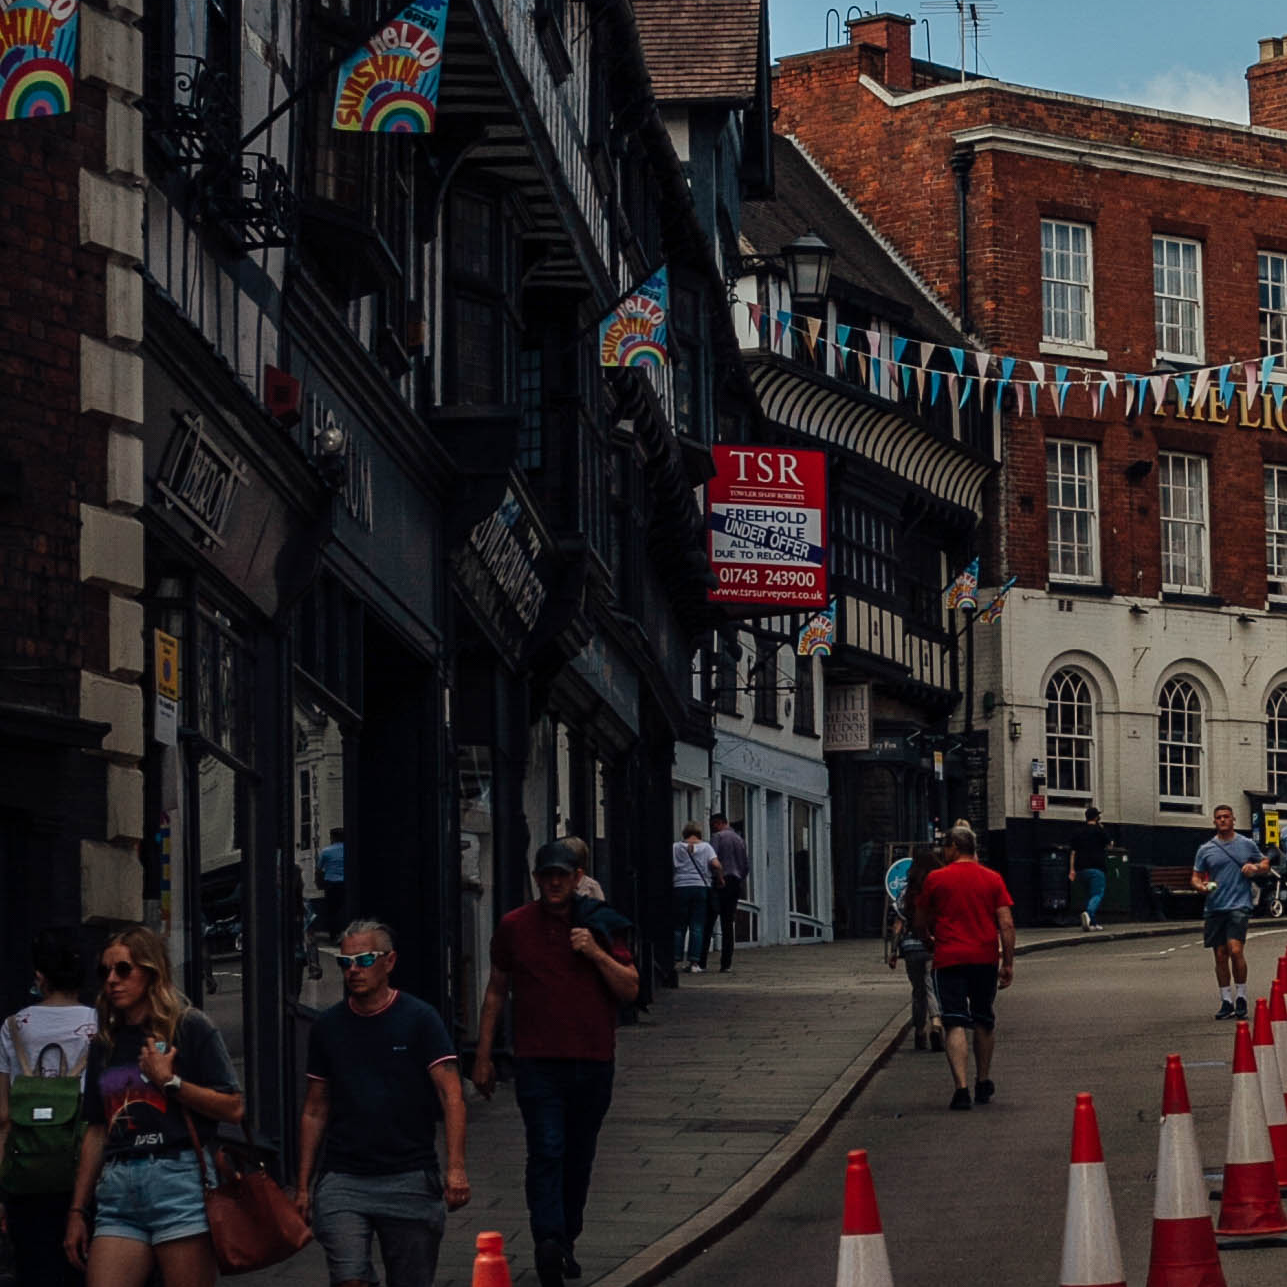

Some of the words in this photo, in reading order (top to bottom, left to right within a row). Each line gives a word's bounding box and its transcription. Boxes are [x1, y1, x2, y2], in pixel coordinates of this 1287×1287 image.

[404, 10, 439, 32] OPEN
[1153, 385, 1230, 425] HE
[729, 450, 804, 486] TSR
[729, 490, 757, 498] TOWLER
[758, 491, 776, 499] SHAW
[777, 492, 805, 501] ROBERTS
[726, 508, 807, 524] FREEHOLD
[725, 518, 766, 544] UNDER
[770, 533, 810, 559] OFFER
[731, 540, 750, 549] ALL
[715, 550, 736, 559] DUE
[741, 551, 754, 560] TO
[720, 568, 758, 584] 01743
[765, 570, 815, 588] 243900
[824, 713, 866, 722] HENRY
[824, 723, 866, 733] TUDOR
[826, 733, 865, 743] HOUSE
[134, 1131, 164, 1146] NASA
